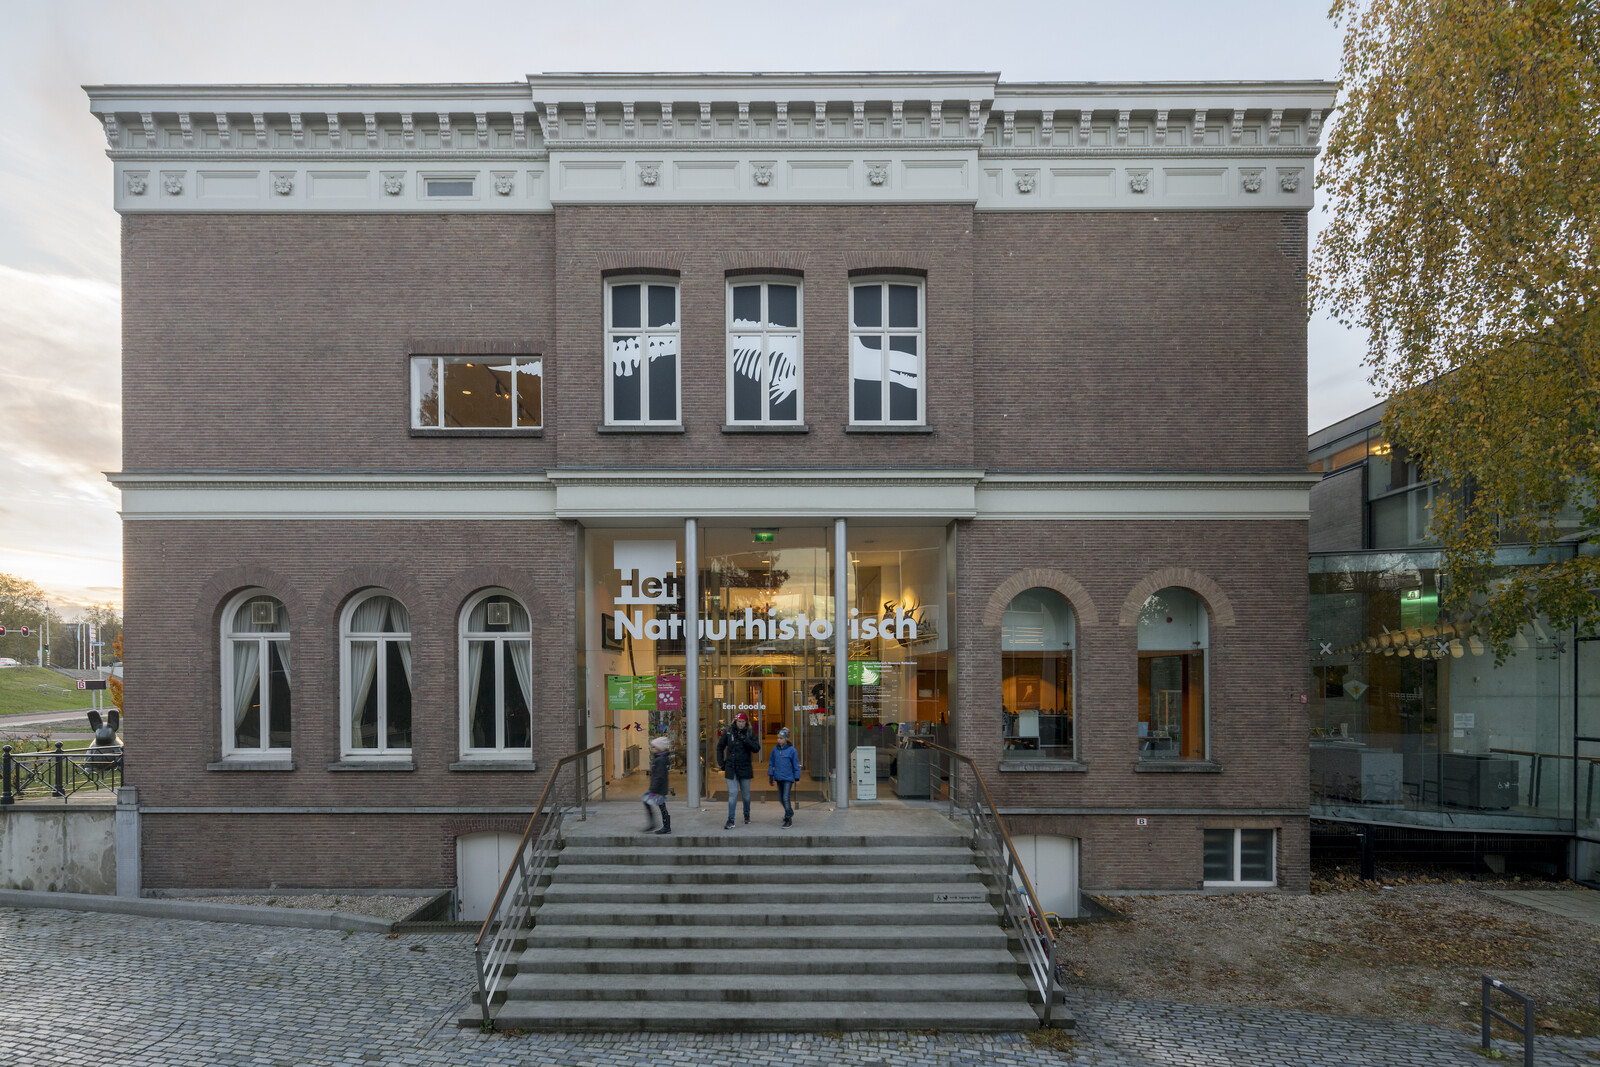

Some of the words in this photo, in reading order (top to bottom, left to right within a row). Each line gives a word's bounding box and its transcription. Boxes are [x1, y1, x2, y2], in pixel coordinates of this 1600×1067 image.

[614, 569, 677, 598] Het
[614, 607, 917, 640] Naturhistoisch
[722, 702, 736, 710] Een
